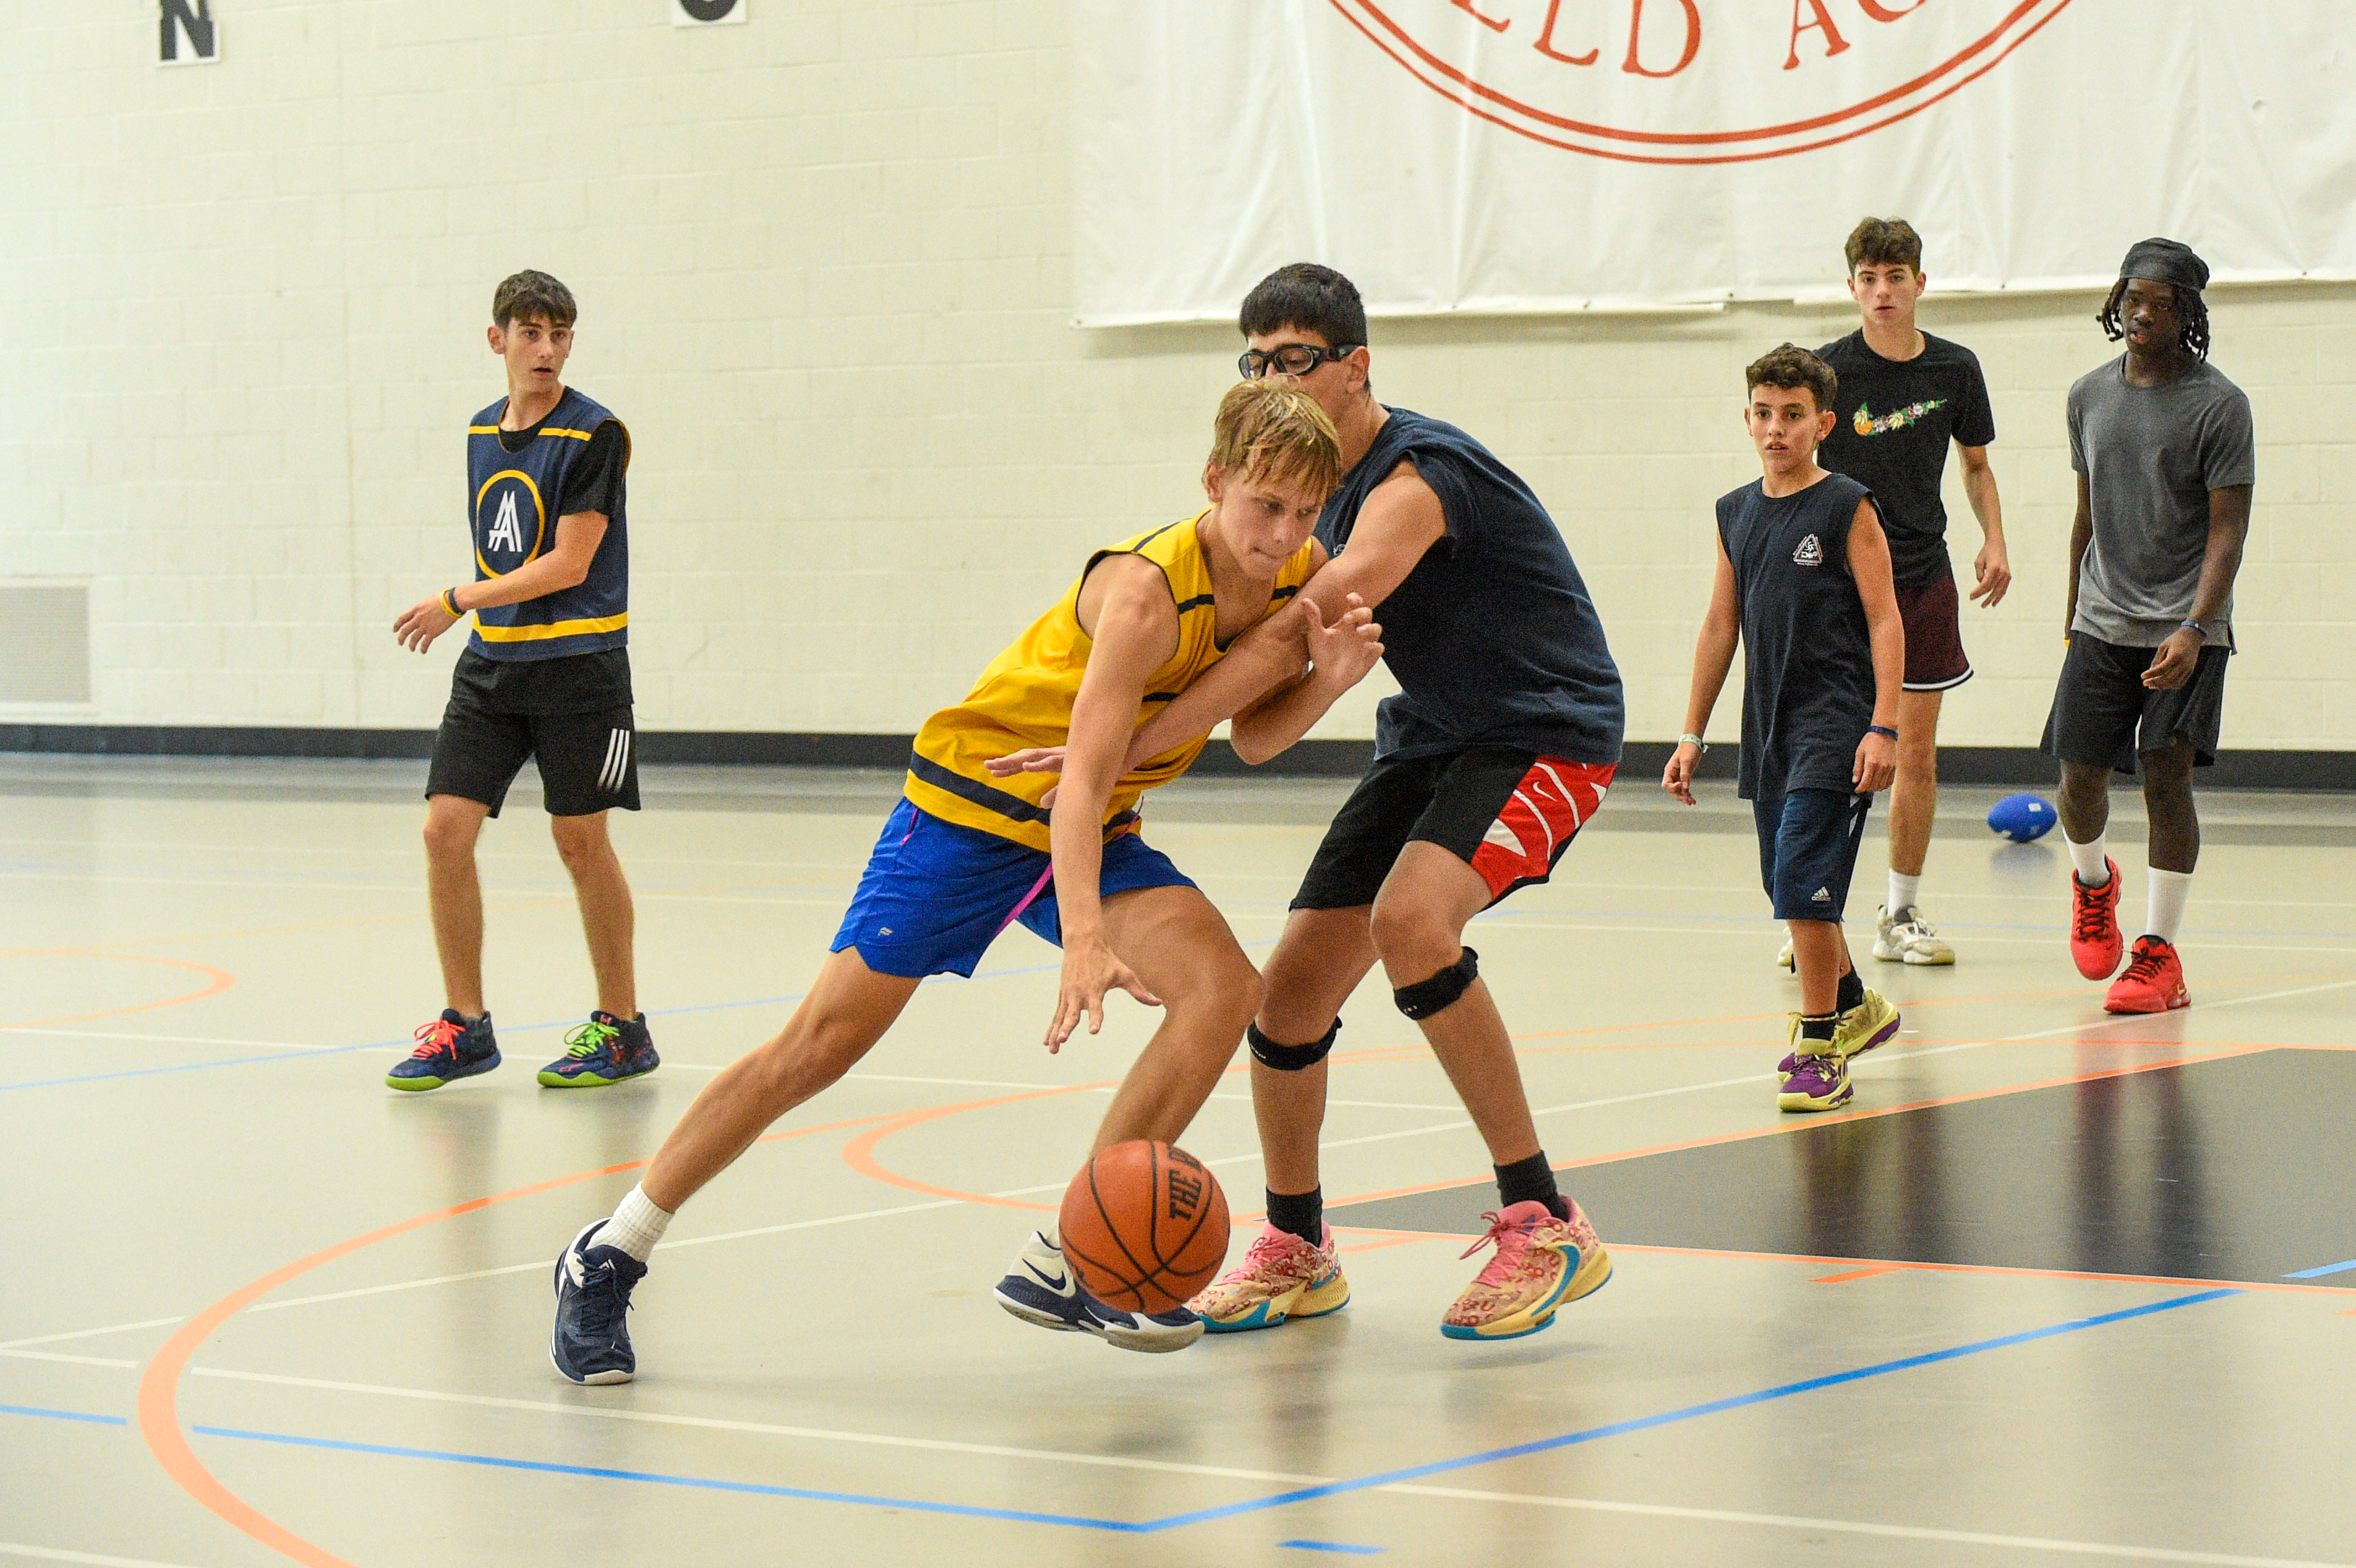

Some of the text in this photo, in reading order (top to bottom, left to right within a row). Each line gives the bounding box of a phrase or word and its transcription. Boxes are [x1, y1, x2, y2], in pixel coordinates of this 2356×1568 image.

[160, 0, 214, 60] N
[1782, 0, 1927, 70] A
[1168, 1169, 1203, 1221] THE
